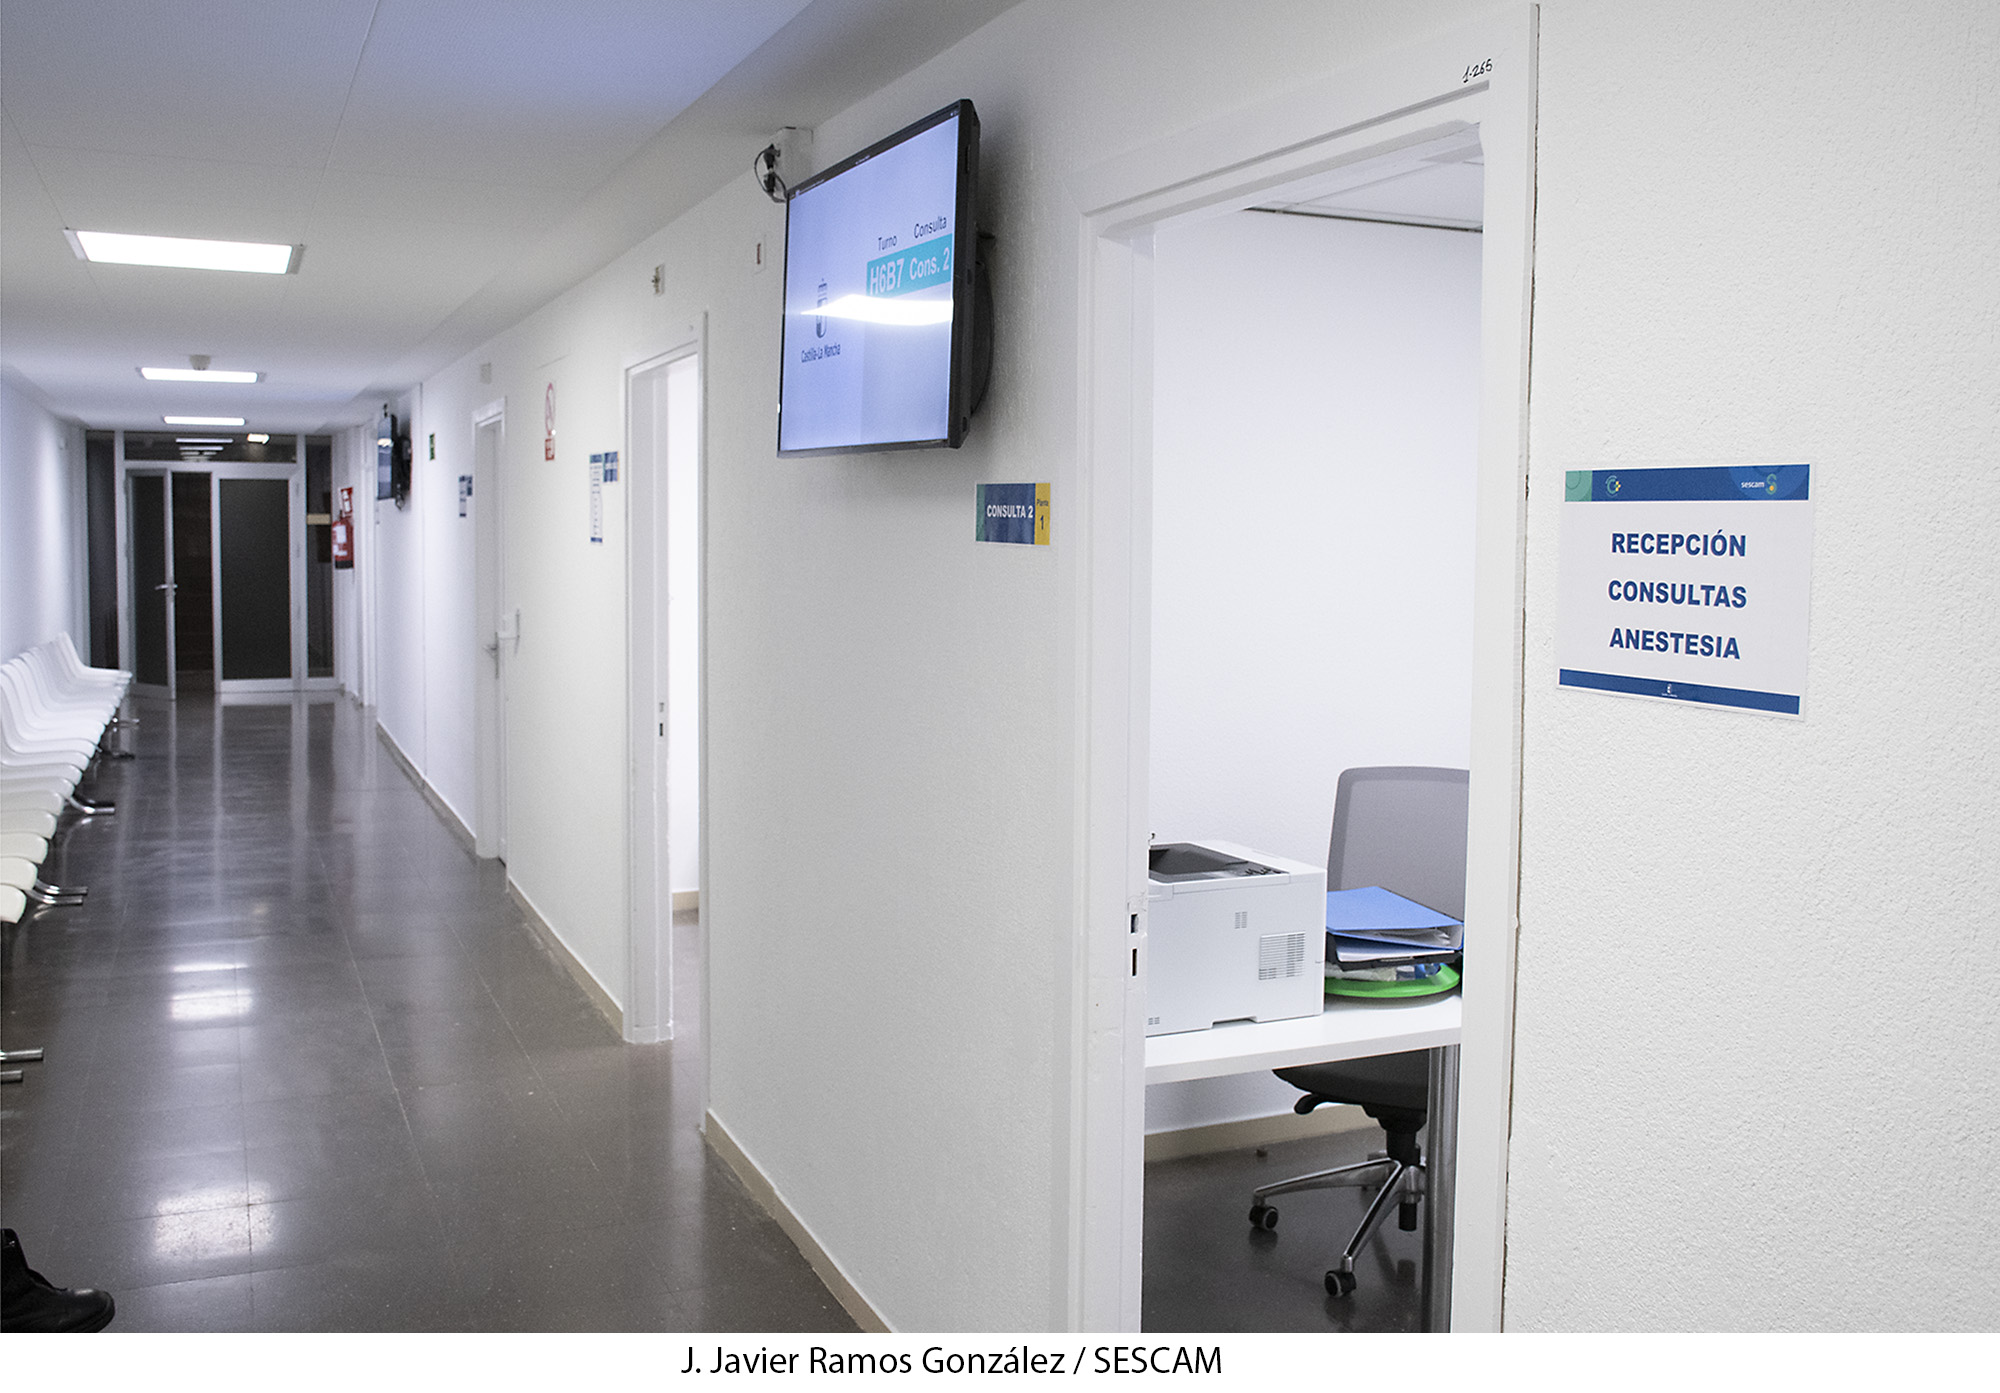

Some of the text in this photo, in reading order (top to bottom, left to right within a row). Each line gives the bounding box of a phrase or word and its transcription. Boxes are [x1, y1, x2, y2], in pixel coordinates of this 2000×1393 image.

[914, 216, 947, 239] Consulta
[878, 235, 898, 251] Turno
[869, 247, 950, 296] H6B7 Cons. 2
[1741, 480, 1765, 489] sescam
[986, 504, 1034, 518] CONSULTA 2
[1040, 514, 1045, 530] 1
[1611, 529, 1747, 557] RECEPCIÓN
[1608, 580, 1747, 608] CONSULTAS
[1609, 628, 1741, 660] ANESTESIA
